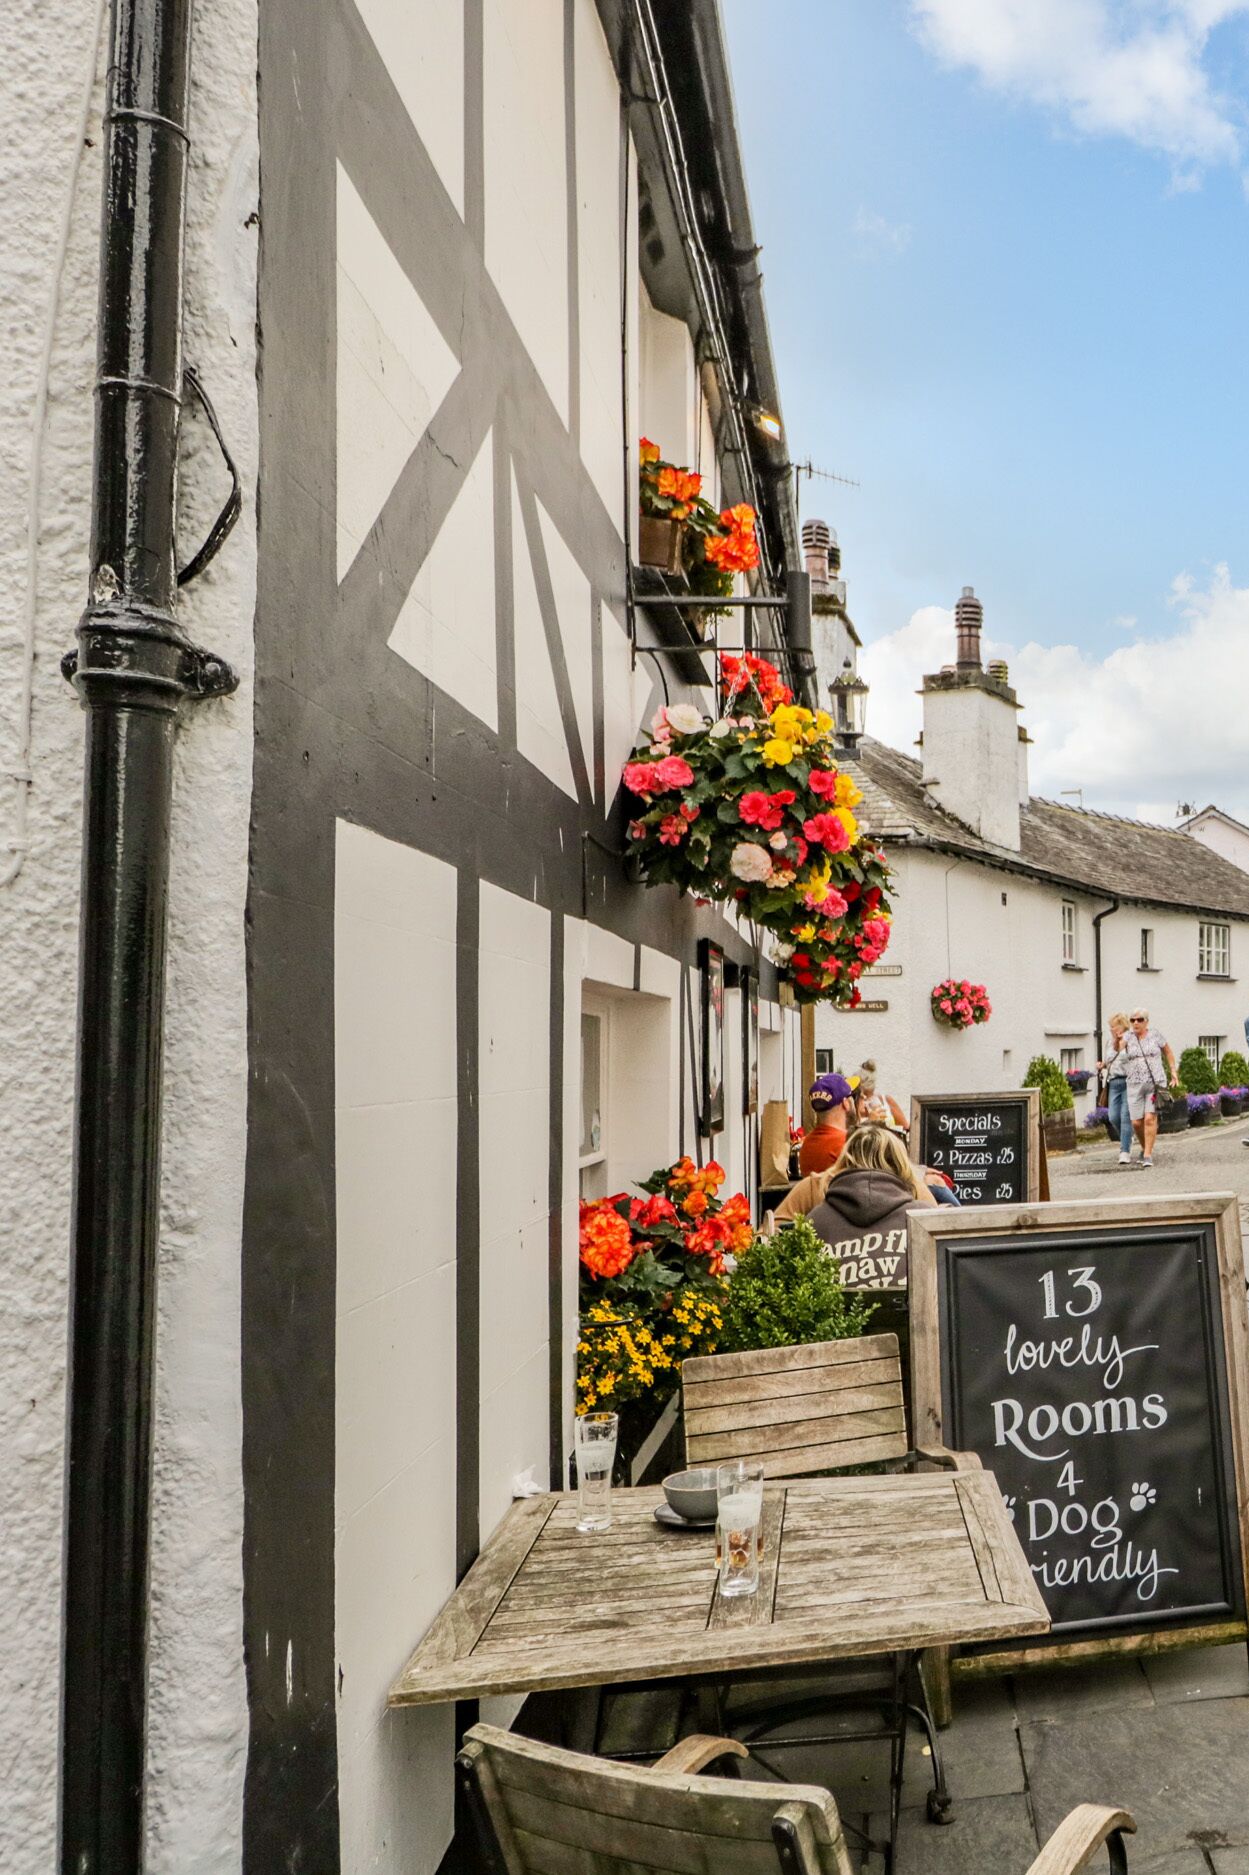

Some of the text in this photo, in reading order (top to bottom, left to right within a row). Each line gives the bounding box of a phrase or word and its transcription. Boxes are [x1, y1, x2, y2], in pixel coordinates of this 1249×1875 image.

[938, 1112, 1002, 1136] Specials
[933, 1150, 944, 1166] 2
[949, 1149, 993, 1165] Pizzas
[819, 1232, 883, 1258] amp
[1038, 1266, 1102, 1319] 13
[1004, 1323, 1160, 1390] lovely
[991, 1393, 1169, 1461] Rooms
[1056, 1460, 1084, 1496] 4
[1028, 1495, 1124, 1548] Dog
[1030, 1541, 1180, 1601] riendly
